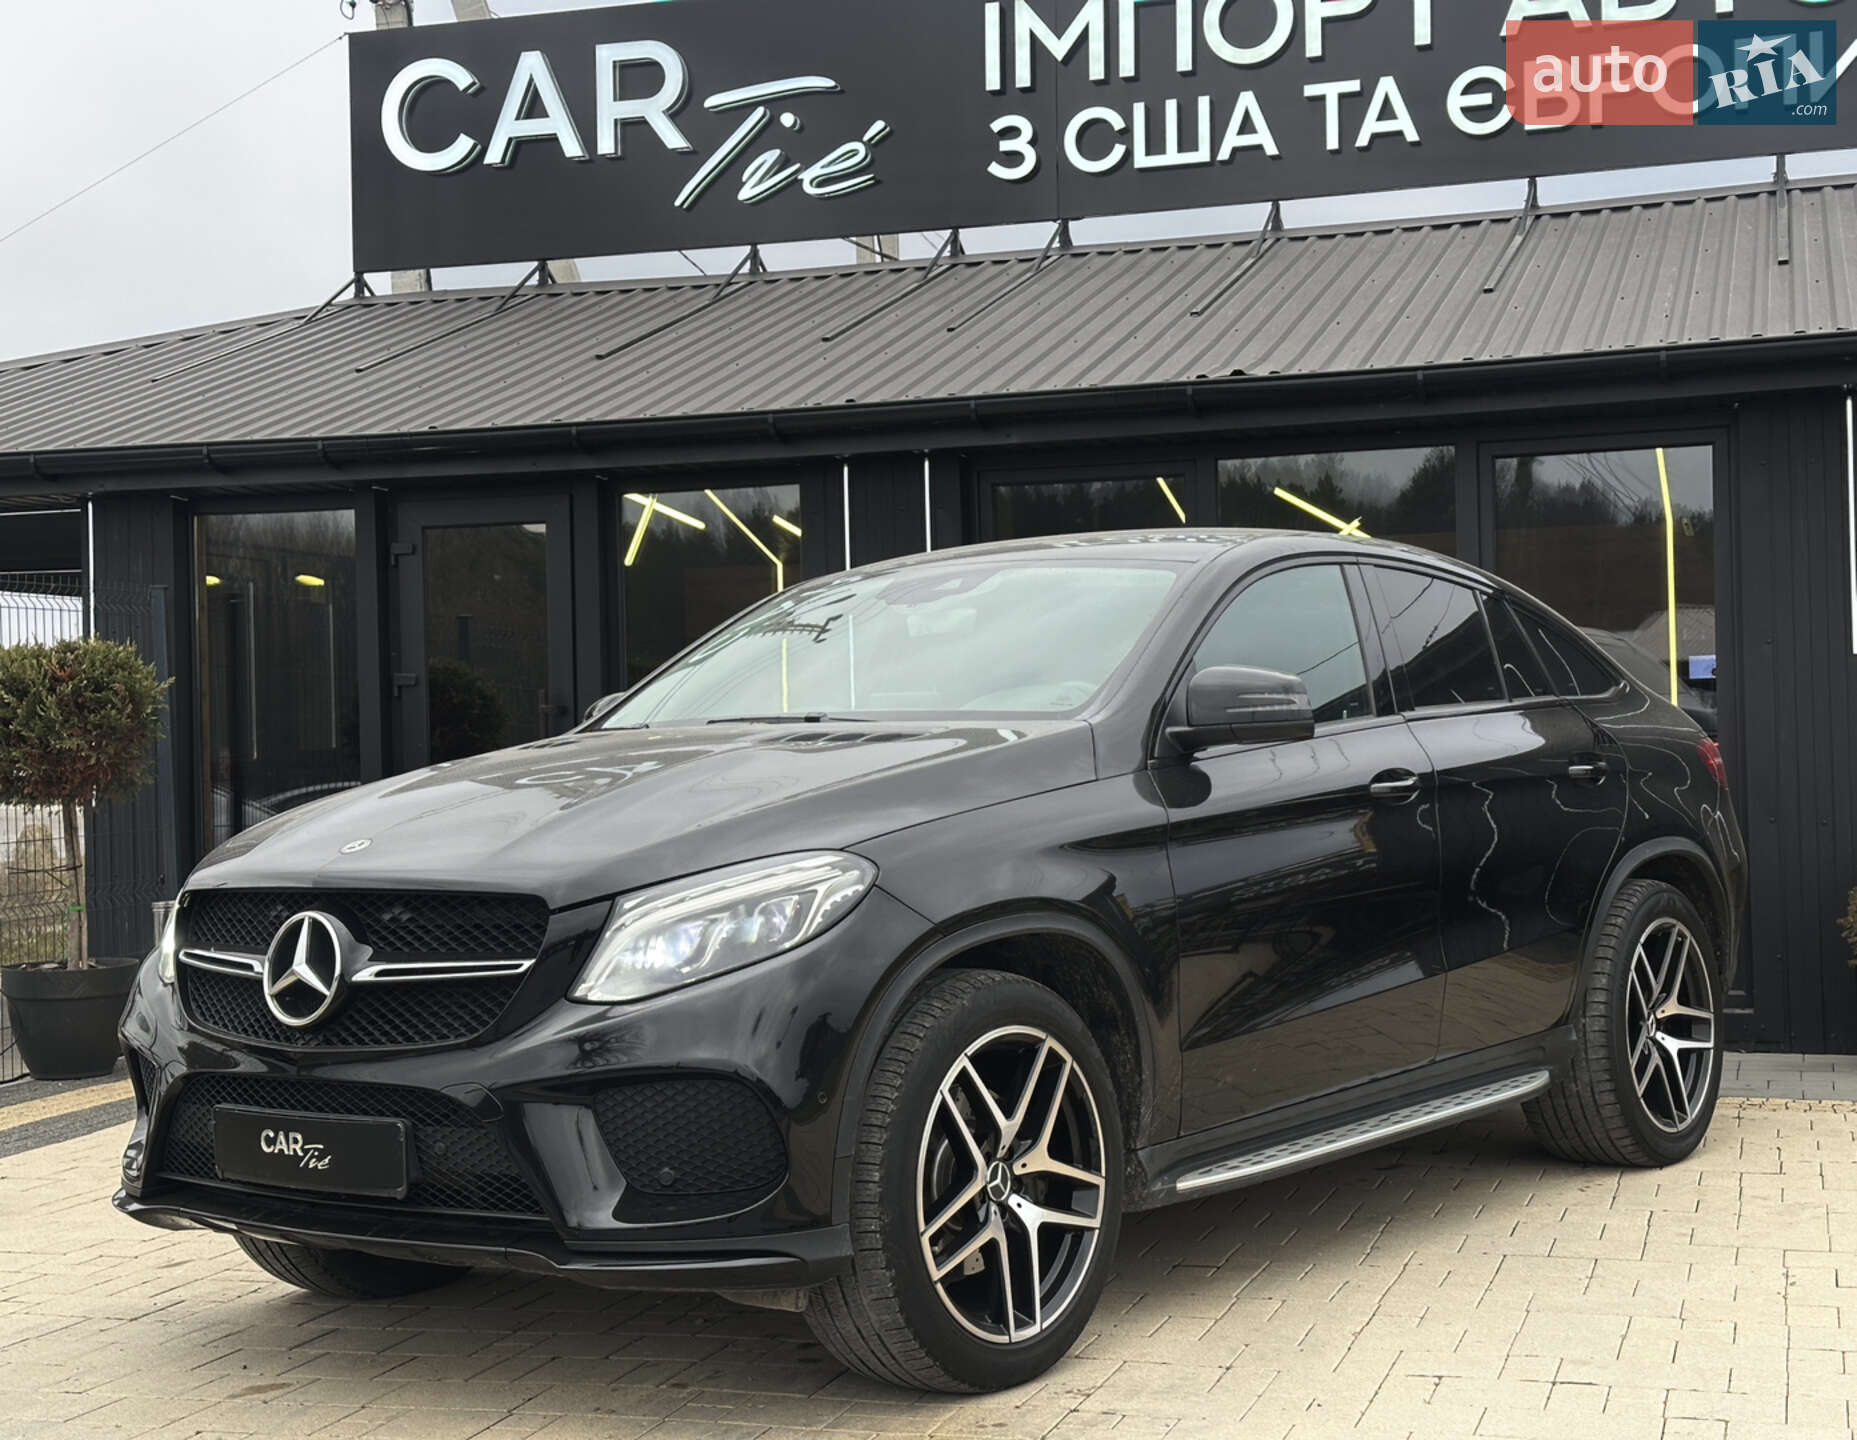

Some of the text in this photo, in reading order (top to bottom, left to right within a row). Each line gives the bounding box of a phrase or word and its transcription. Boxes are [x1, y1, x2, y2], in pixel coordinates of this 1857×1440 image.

[380, 39, 693, 174] CAR
[1063, 90, 1281, 174] США
[1303, 74, 1421, 151] ТА
[260, 1128, 304, 1157] CAR
